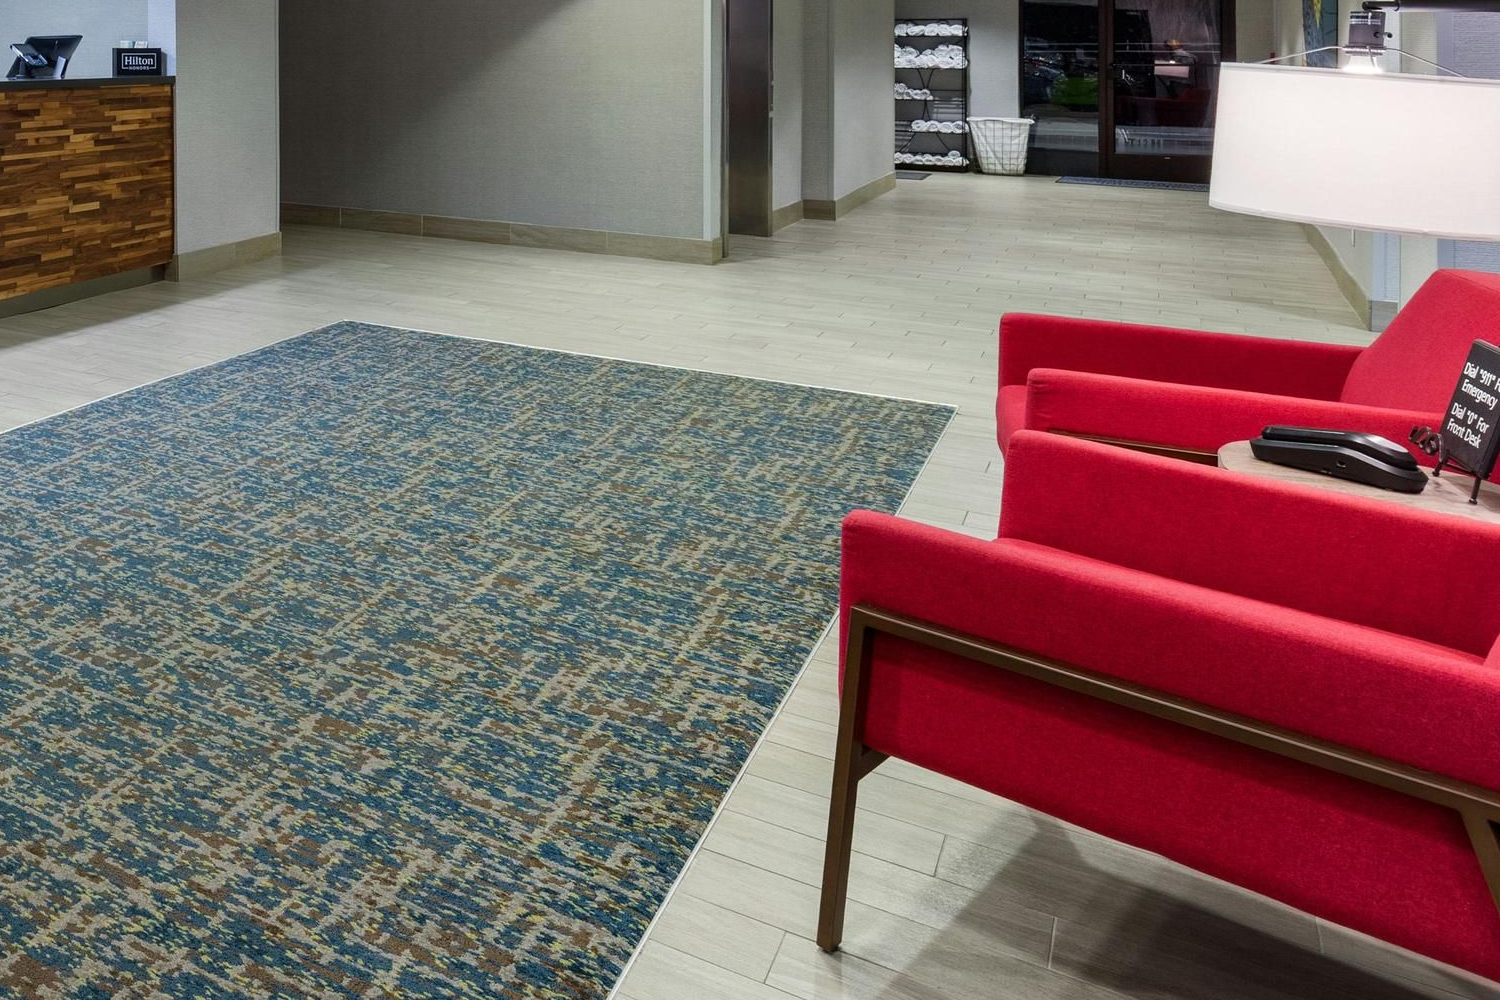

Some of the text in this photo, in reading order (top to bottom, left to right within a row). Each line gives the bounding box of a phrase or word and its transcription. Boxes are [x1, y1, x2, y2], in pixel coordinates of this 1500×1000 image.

[124, 56, 154, 66] Hilton
[1463, 362, 1479, 379] Dial
[1479, 369, 1497, 387] "911"
[1461, 379, 1498, 410] Emergency
[1447, 418, 1482, 449] Front Desk
[1451, 402, 1490, 434] Dial "0" For
